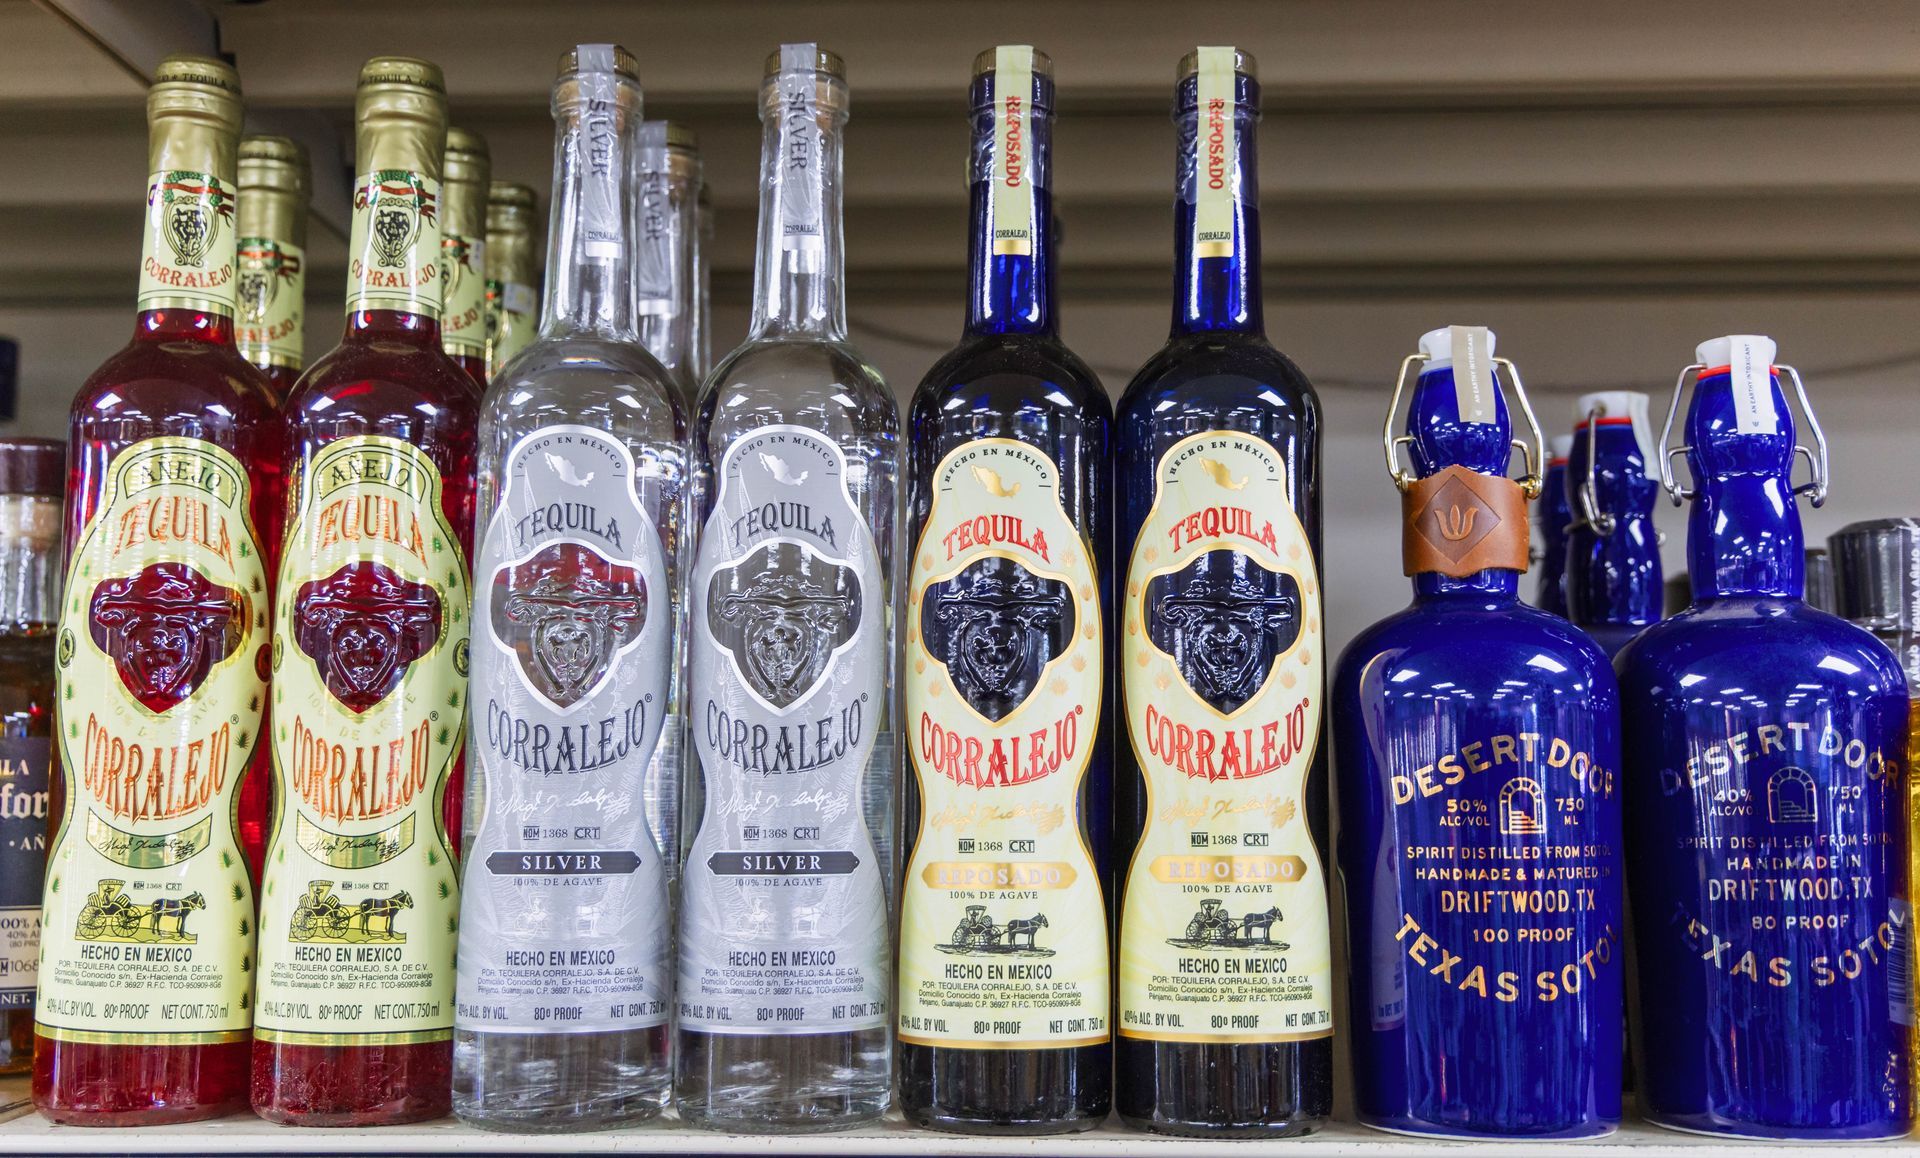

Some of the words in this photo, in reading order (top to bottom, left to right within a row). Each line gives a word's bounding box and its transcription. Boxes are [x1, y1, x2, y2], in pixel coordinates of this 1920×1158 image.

[589, 97, 611, 177] SILVER
[788, 92, 809, 171] SILVER
[1005, 96, 1021, 188] REPOSADO
[1208, 98, 1224, 190] REPOSADO
[995, 229, 1028, 239] CORRALEJO
[1198, 231, 1231, 241] CORRALEJO
[145, 256, 232, 288] CORRALEJO
[517, 439, 550, 469] HECHO
[558, 436, 572, 444] EN
[579, 437, 622, 469] MÉXICO
[732, 439, 763, 470] HECHO
[792, 436, 834, 468] MÉXICO
[1169, 444, 1204, 475] HECHO
[1234, 442, 1275, 474] MÉXICO
[141, 455, 222, 491] AÑEJO
[944, 452, 976, 483] HECHO
[1005, 451, 1047, 479] MÉXICO
[311, 495, 427, 570] TEQUILA
[515, 502, 623, 552] TEQUILA
[731, 502, 838, 552] TEQUILA
[1168, 506, 1279, 557] TEQUILA
[112, 496, 236, 575] TEQUILA
[943, 514, 1051, 564] TEQUILA
[488, 699, 645, 777] CORRALEJO
[707, 699, 861, 778] CORRALEJO
[1146, 703, 1304, 784] CORRALEJO
[921, 710, 1077, 791] CORRALEJO
[1818, 725, 1900, 789] DOOR
[84, 712, 230, 825] CORRALEJO
[293, 714, 430, 827] CORRALEJO
[1391, 733, 1540, 805] DESERT
[1714, 789, 1752, 802] 40%
[1447, 800, 1487, 811] 50%
[1555, 798, 1584, 811] 750
[1440, 816, 1490, 826] ALC/VOL
[1564, 816, 1578, 824] ML
[523, 827, 540, 840] NOM
[543, 829, 568, 838] 1368
[574, 827, 600, 840] CRT
[743, 827, 760, 840] NOM
[763, 829, 788, 838] 1368
[793, 827, 819, 840] CRT
[1191, 832, 1208, 846] NOM
[1212, 835, 1238, 844] 1368
[1243, 833, 1269, 846] CRT
[958, 839, 975, 852] NOM
[978, 842, 1003, 851] 1368
[1009, 840, 1035, 853] CRT
[1407, 847, 1455, 859] SPIRIT
[1461, 847, 1540, 860] DISTILLED
[1545, 846, 1580, 857] FROM
[522, 855, 602, 870] SILVER
[743, 855, 822, 870] SILVER
[1169, 862, 1294, 878] REPOSADO
[1727, 855, 1839, 870] HANDMADE
[1846, 854, 1861, 868] IN
[939, 868, 1061, 885] REPOSADO
[1416, 869, 1511, 880] HANDMADE
[1516, 868, 1527, 880] &
[1534, 867, 1598, 880] MATURED
[514, 878, 539, 887] 100%
[544, 877, 559, 886] DE
[563, 877, 603, 887] AGAVE
[735, 878, 759, 887] 100%
[764, 877, 779, 887] DE
[783, 877, 823, 887] AGAVE
[1182, 885, 1210, 893] 100%
[1215, 885, 1230, 893] DE
[1235, 885, 1273, 893] AGAVE
[950, 891, 975, 899] 100%
[980, 891, 995, 899] DE
[999, 891, 1038, 899] AGAVE
[1752, 916, 1776, 929] 80
[1786, 915, 1849, 929] PROOF
[1473, 928, 1509, 942] 100
[1517, 928, 1575, 942] PROOF
[81, 945, 119, 960] HECHO
[125, 947, 140, 961] EN
[151, 947, 192, 962] MEXICO
[295, 947, 331, 961] HECHO
[336, 948, 351, 961] EN
[356, 947, 402, 962] MEXICO
[506, 950, 545, 966] HECHO
[550, 951, 565, 966] EN
[570, 950, 615, 965] MEXICO
[729, 951, 767, 966] HECHO
[771, 951, 787, 966] EN
[792, 951, 836, 966] MEXICO
[1395, 913, 1519, 1002] TEXAS
[945, 964, 983, 979] HECHO
[988, 965, 1003, 979] EN
[1008, 964, 1052, 979] MEXICO
[1179, 958, 1220, 974] HECHO
[1225, 958, 1240, 973] EN
[1245, 958, 1288, 973] MEXICO
[1152, 975, 1169, 983] POR:
[1171, 976, 1216, 985] TEQUILERA
[1218, 976, 1270, 985] CORRALEJO,
[1180, 985, 1217, 993] Conocido
[1238, 985, 1285, 993] Ex-Hacienda
[777, 1007, 805, 1020] PROOF
[1232, 1015, 1260, 1028] PROOF
[993, 1021, 1022, 1034] PROOF
